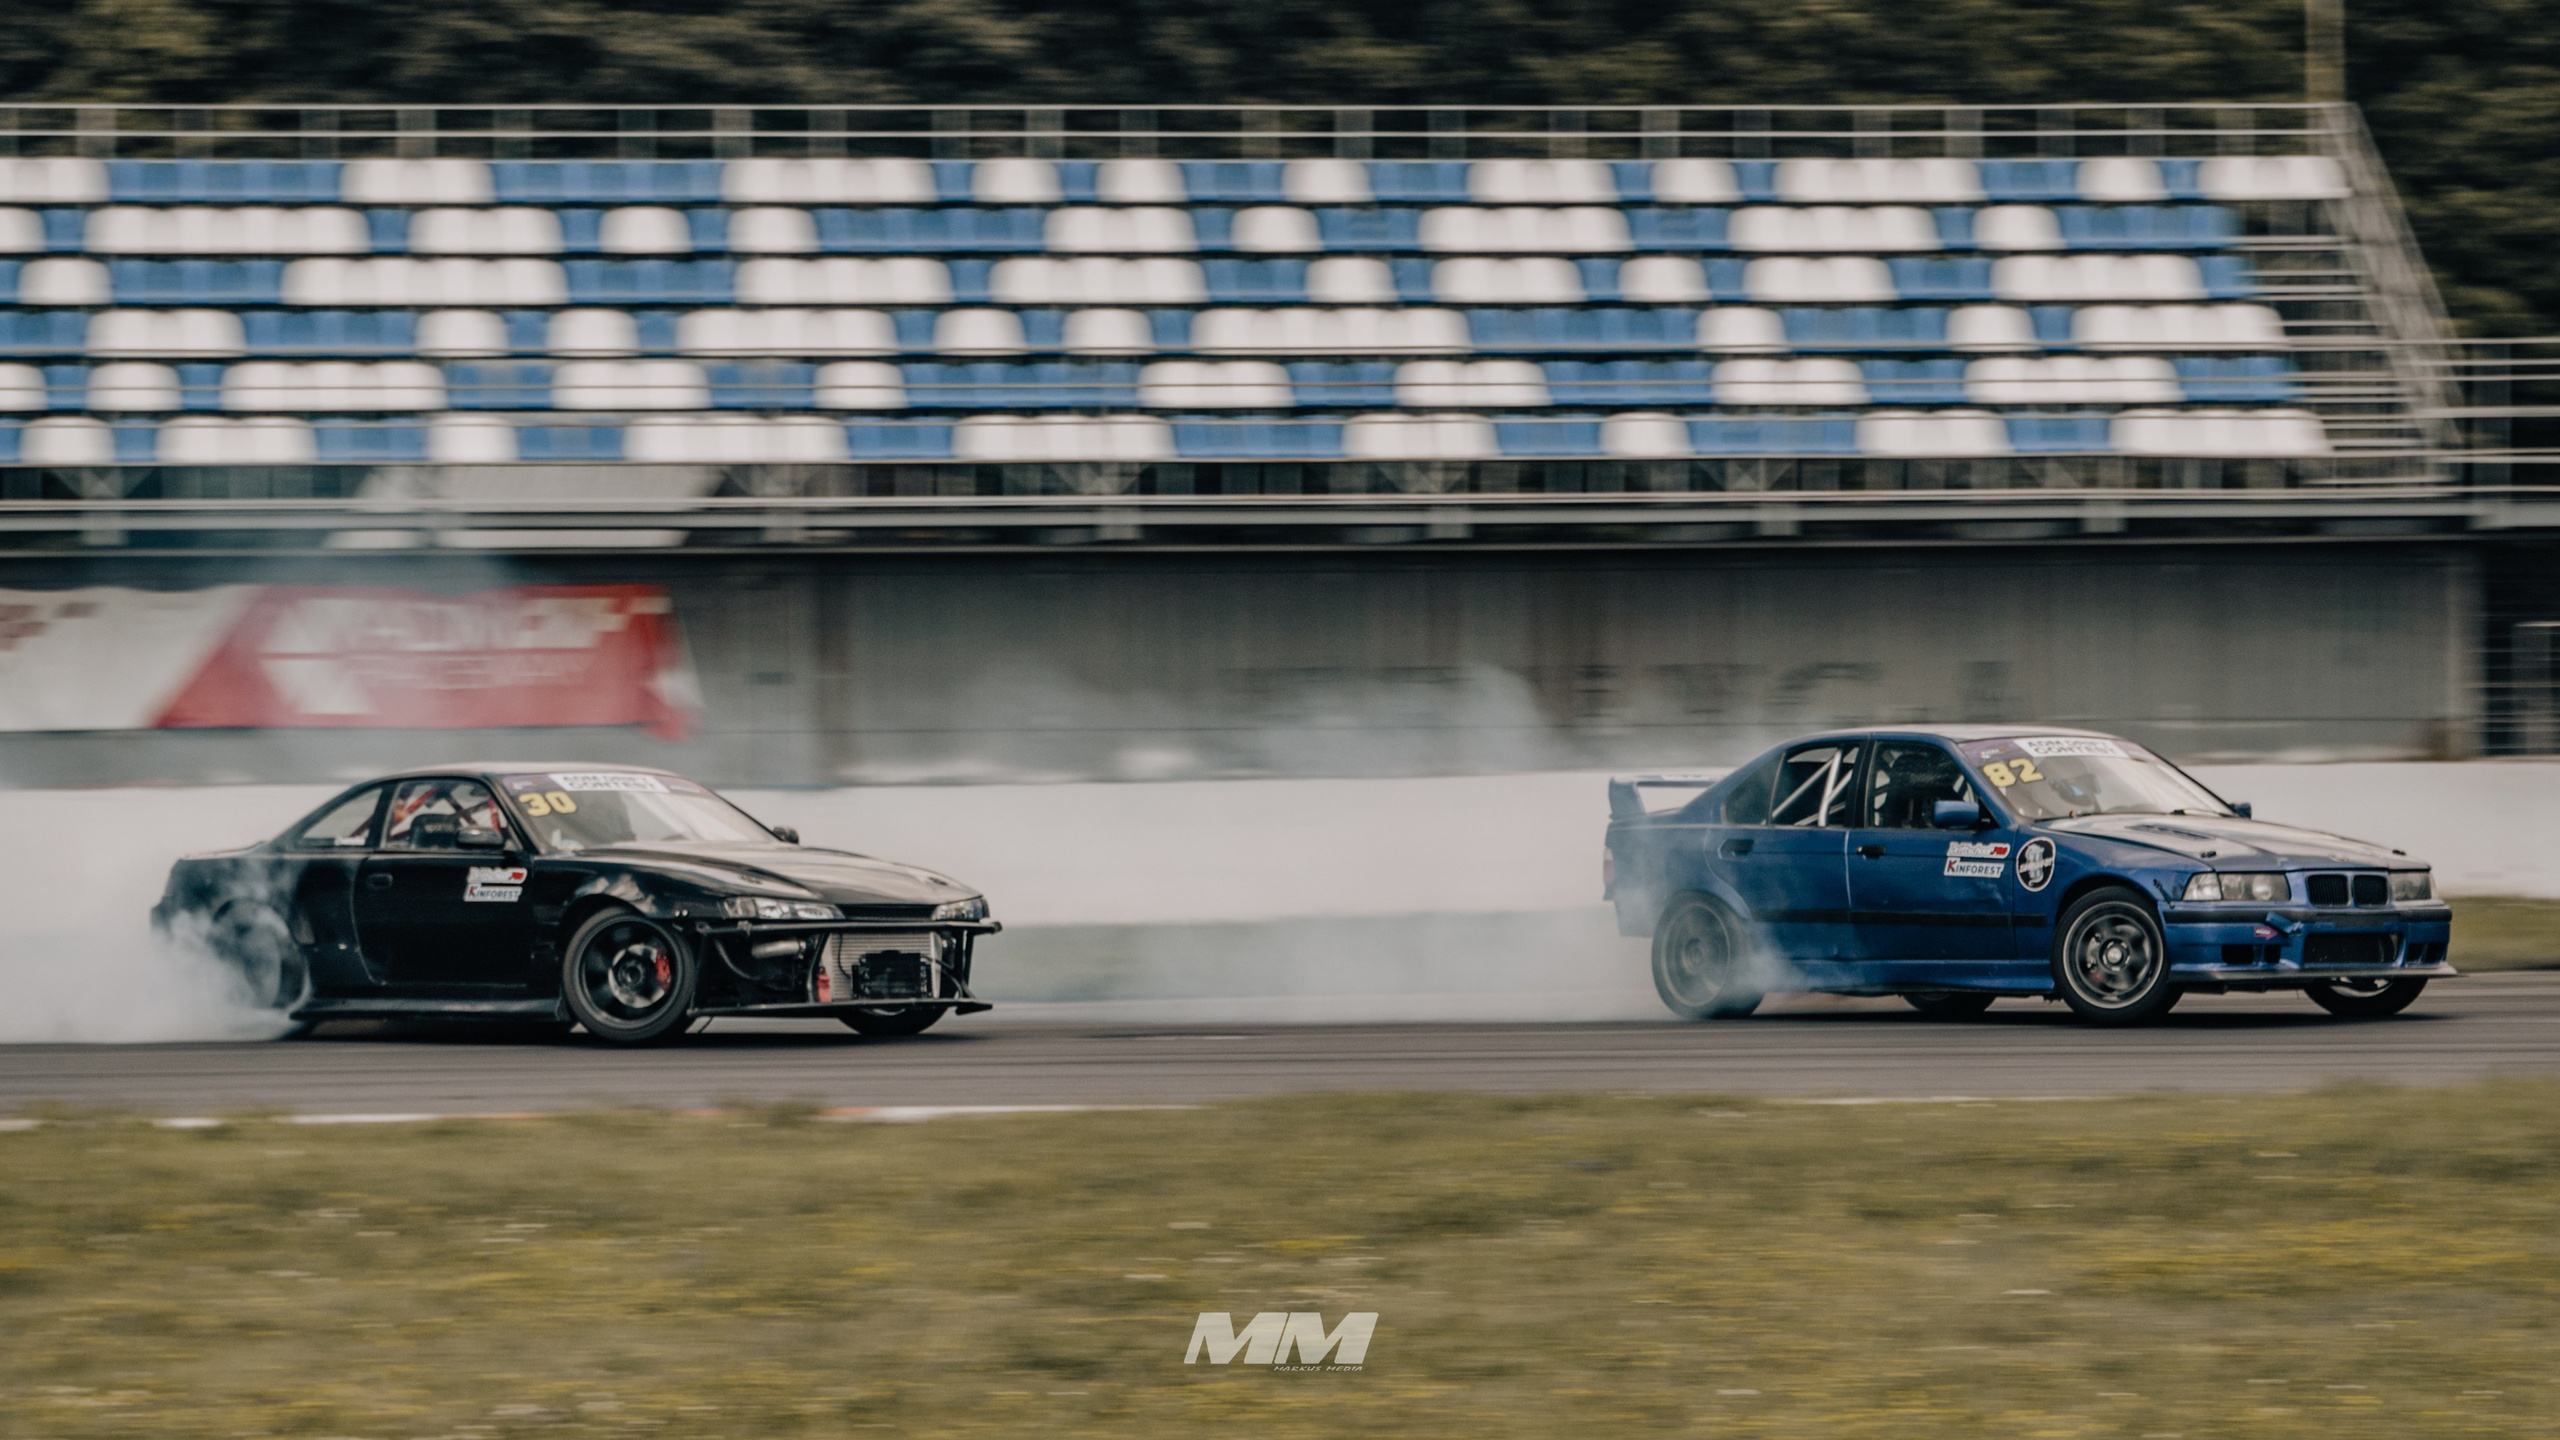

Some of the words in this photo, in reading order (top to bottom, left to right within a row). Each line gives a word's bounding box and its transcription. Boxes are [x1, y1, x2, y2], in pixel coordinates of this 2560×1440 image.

[1983, 758, 2044, 788] 82
[519, 791, 577, 817] 30
[1947, 860, 2002, 874] KINFOREST
